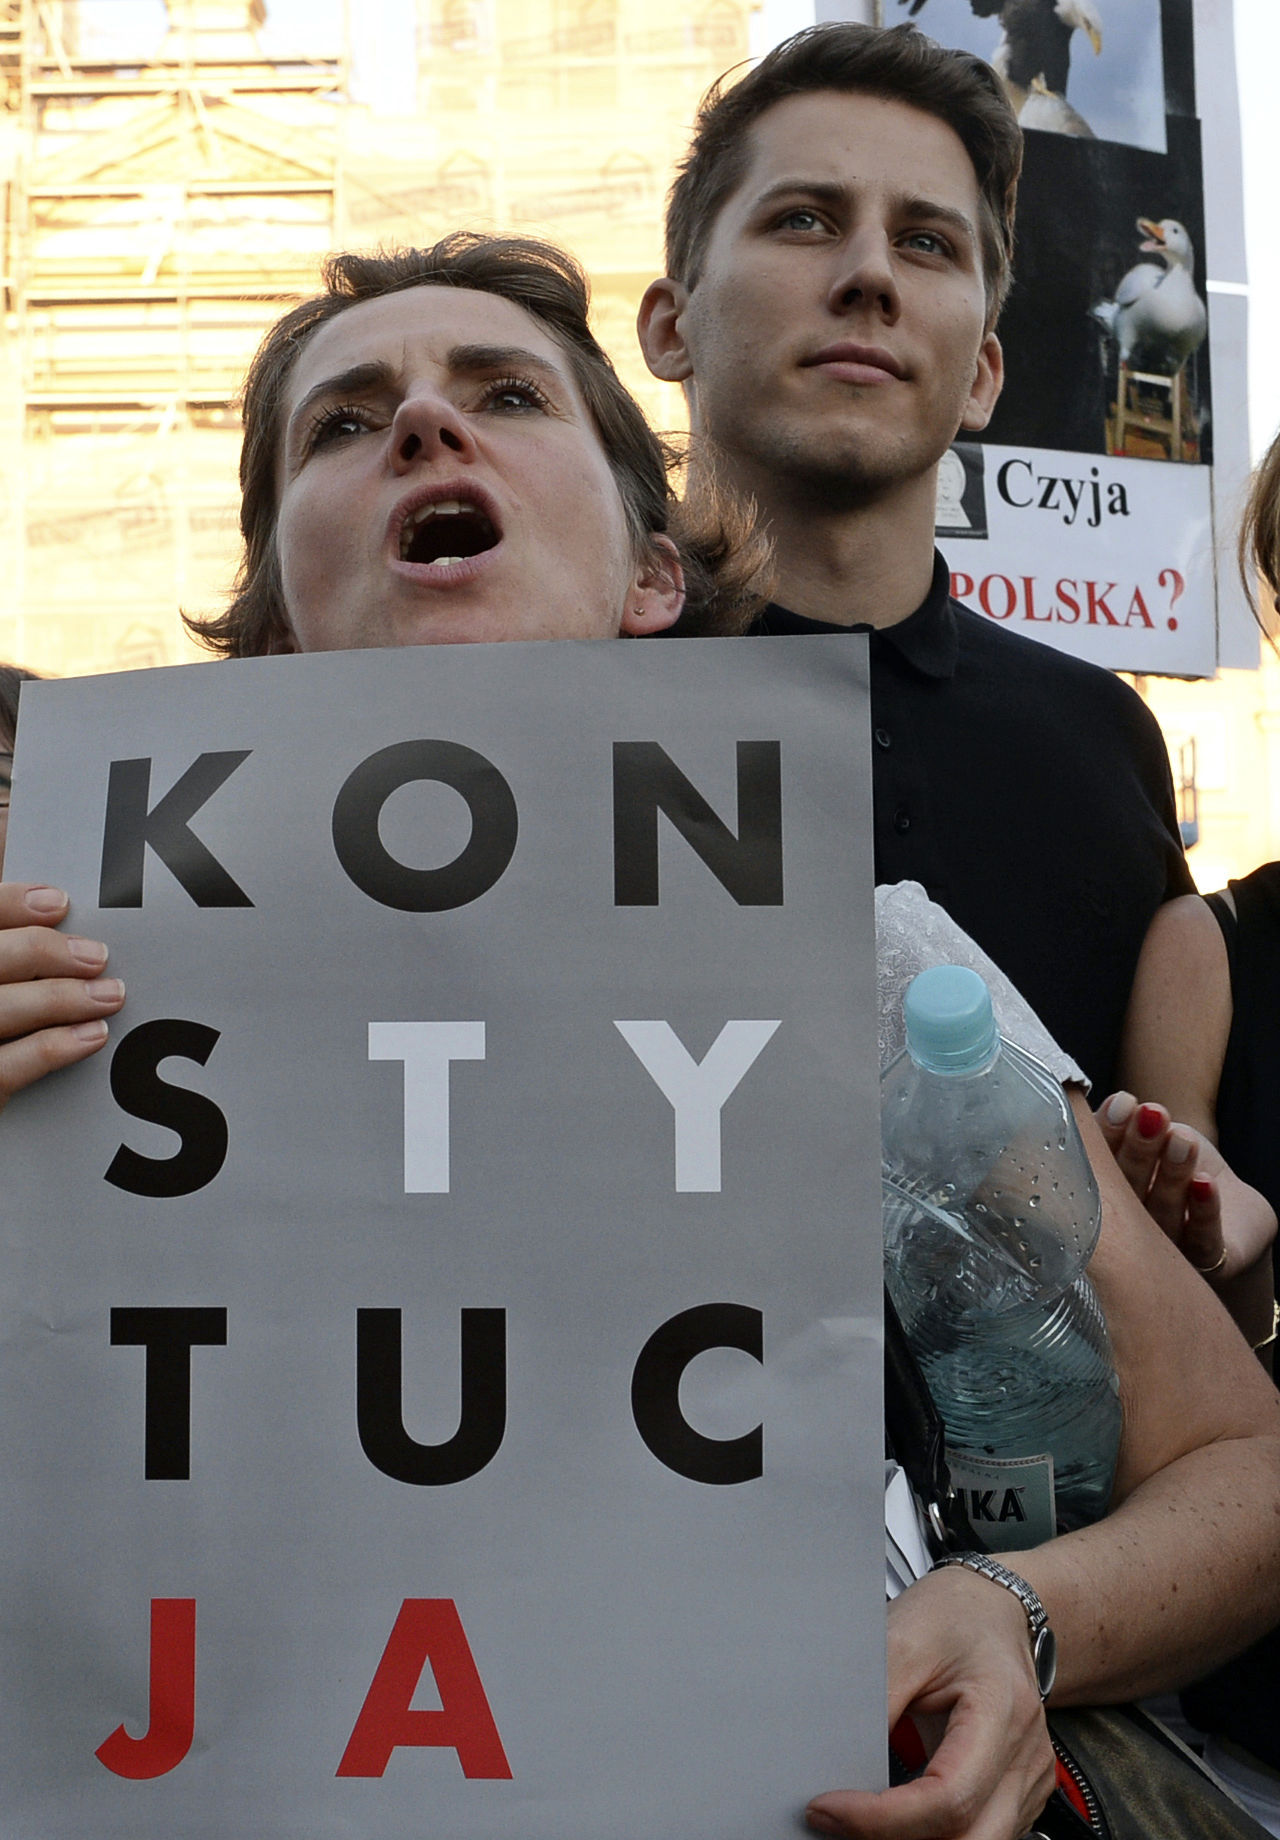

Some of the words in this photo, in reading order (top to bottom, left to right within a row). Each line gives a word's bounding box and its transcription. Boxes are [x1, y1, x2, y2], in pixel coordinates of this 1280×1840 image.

[997, 459, 1130, 528] Czyja
[949, 568, 1185, 632] POLSKA?
[98, 739, 784, 914] KON
[103, 1018, 783, 1199] STY
[109, 1302, 764, 1487] TUC
[94, 1598, 513, 1780] JA
